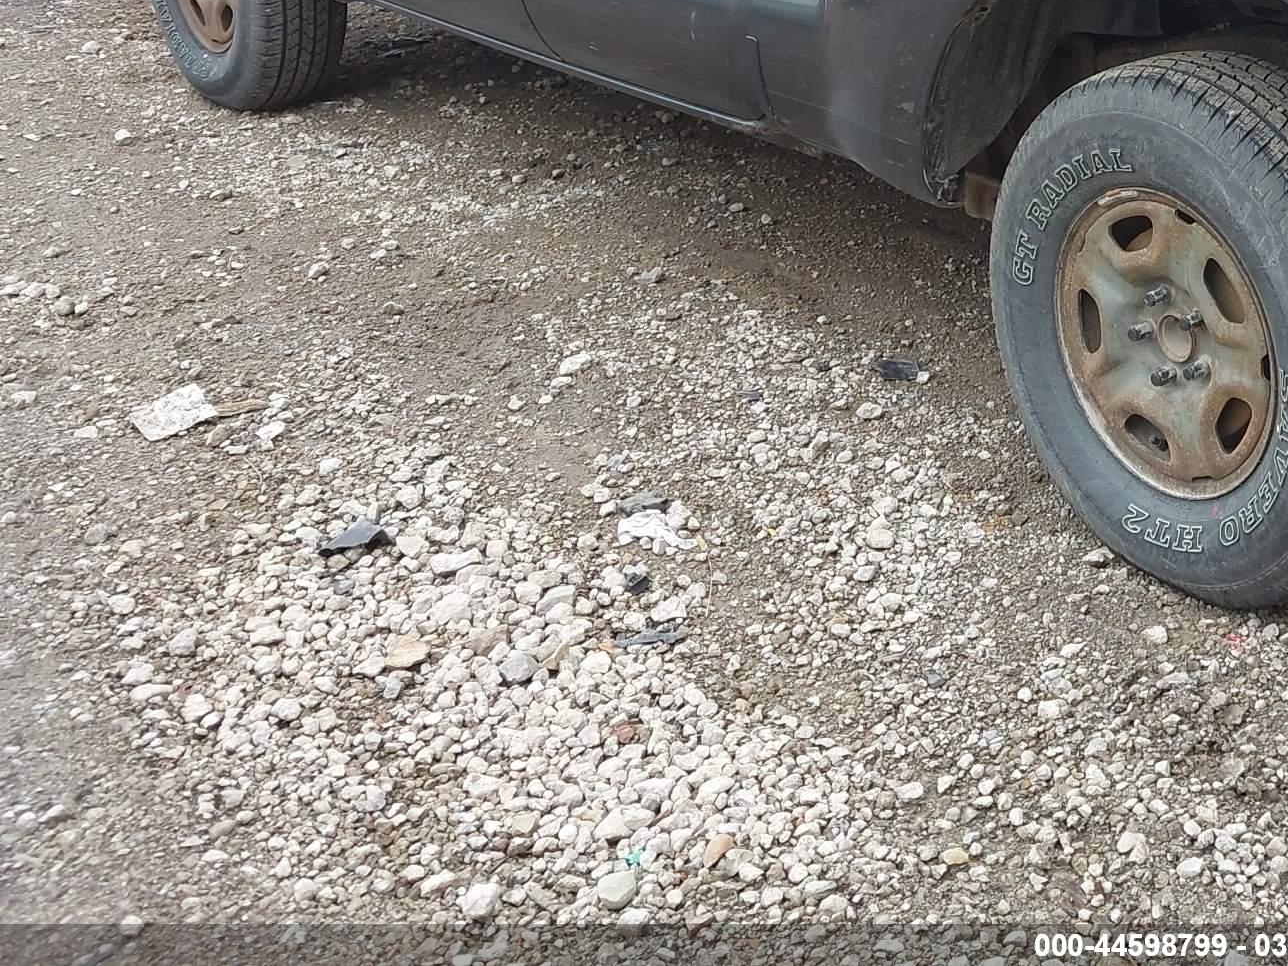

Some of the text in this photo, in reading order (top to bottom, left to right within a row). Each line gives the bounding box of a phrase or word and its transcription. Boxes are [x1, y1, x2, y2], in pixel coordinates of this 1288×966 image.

[1011, 148, 1135, 287] GT RADIAL
[1121, 502, 1204, 554] HT2
